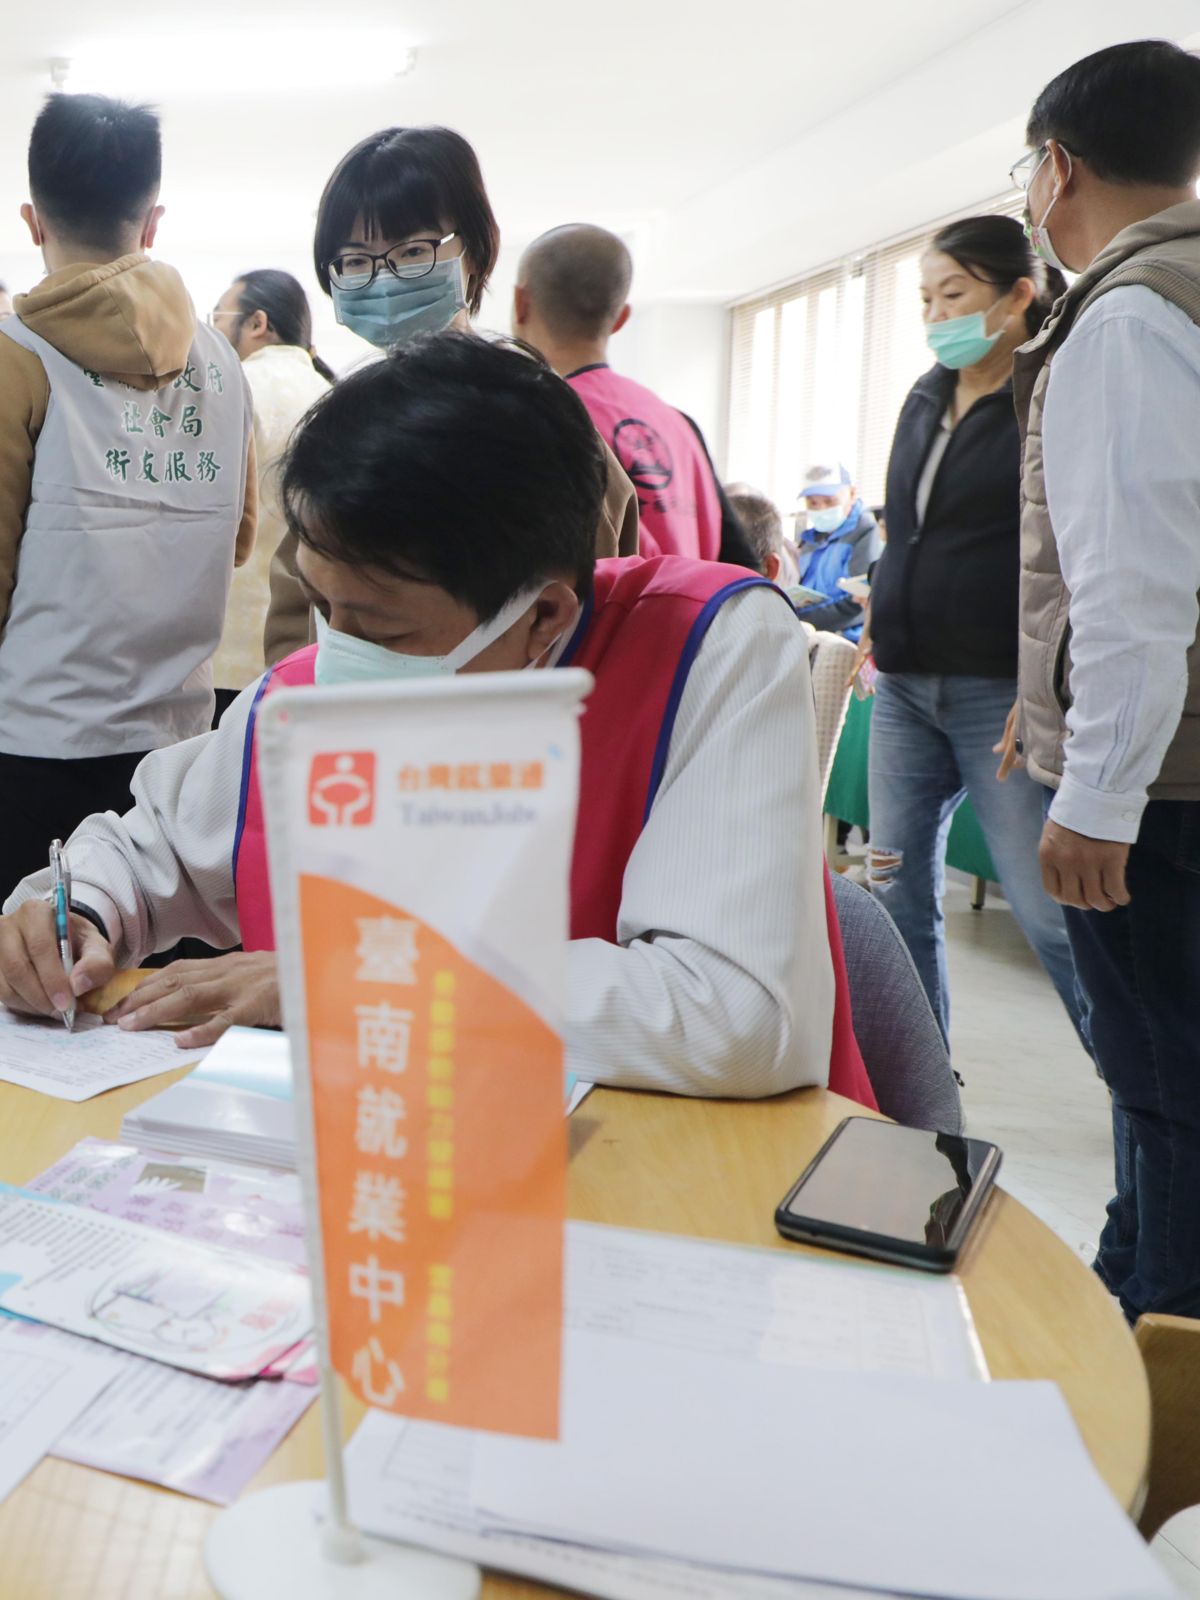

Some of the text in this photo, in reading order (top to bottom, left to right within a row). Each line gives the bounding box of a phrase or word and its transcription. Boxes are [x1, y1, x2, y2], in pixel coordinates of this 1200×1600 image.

[123, 402, 203, 438] 社會局
[105, 448, 222, 484] 街友服務
[347, 915, 419, 1407] 臺南就業中心
